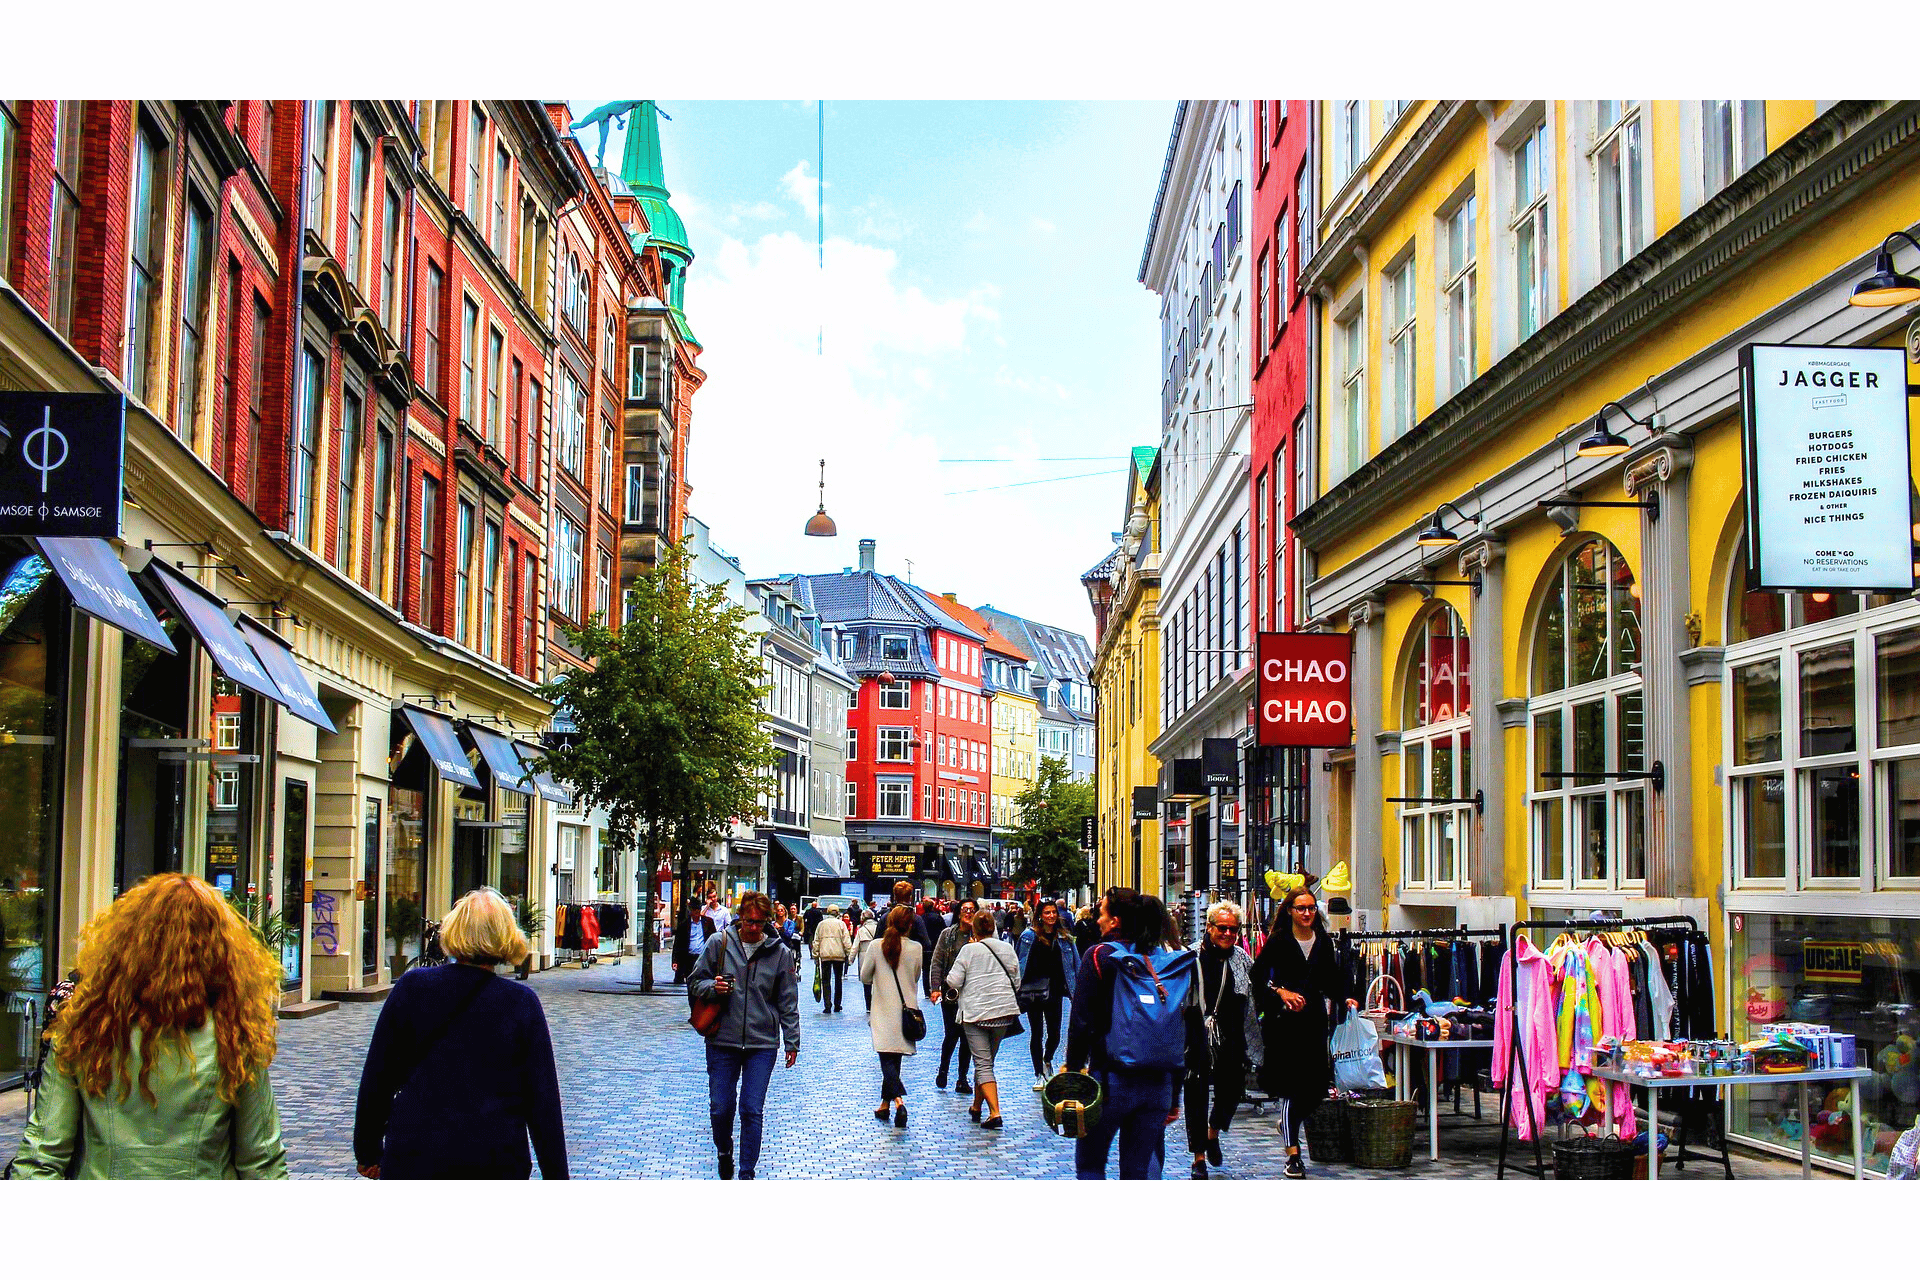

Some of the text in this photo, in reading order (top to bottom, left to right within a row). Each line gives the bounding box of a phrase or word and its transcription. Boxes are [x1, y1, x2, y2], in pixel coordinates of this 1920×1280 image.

[1779, 370, 1879, 388] JAGGER
[1809, 430, 1853, 440] BURGERS
[1809, 442, 1854, 451] HOTDOGS
[1796, 453, 1868, 465] FRIED CHICKEN
[1819, 466, 1845, 475] FRIES
[1803, 477, 1863, 488] MILKSHAKES
[1789, 488, 1877, 501] FROZEN DAIQUIRIS
[53, 506, 102, 517] SAMSØE
[1804, 513, 1864, 524] NICE THINGS
[1263, 659, 1346, 682] CHAO
[1263, 699, 1347, 723] CHAO
[1805, 948, 1861, 971] UDSALG
